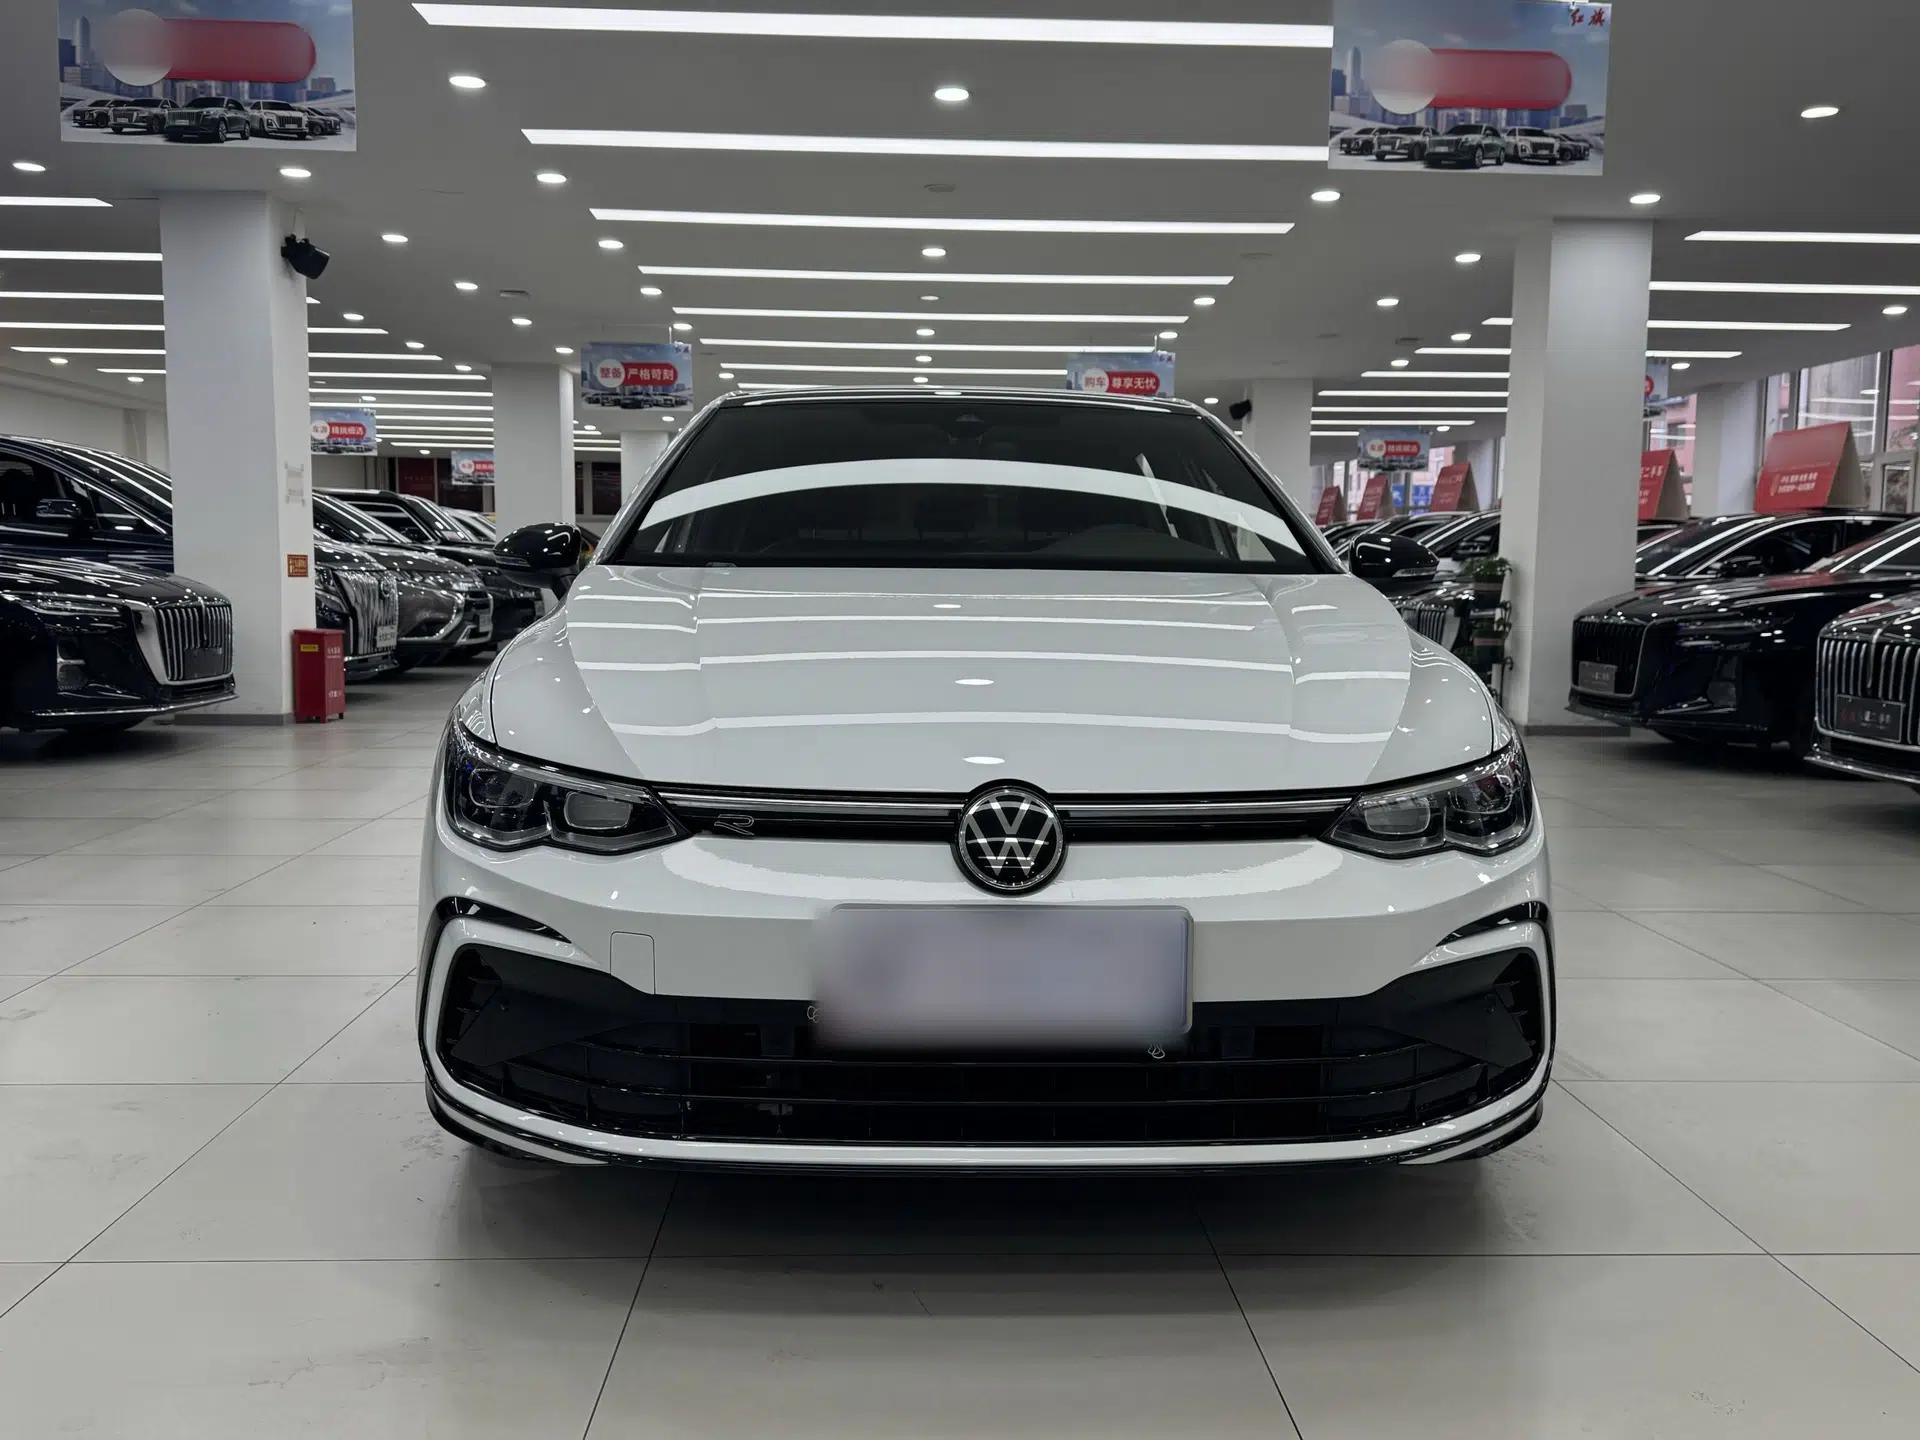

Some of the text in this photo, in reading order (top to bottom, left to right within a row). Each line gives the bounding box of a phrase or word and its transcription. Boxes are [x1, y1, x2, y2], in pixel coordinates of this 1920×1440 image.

[1571, 8, 1606, 27] 红旗
[627, 367, 674, 381] 严格苛刻
[1084, 376, 1156, 389] 购车 尊享无忧
